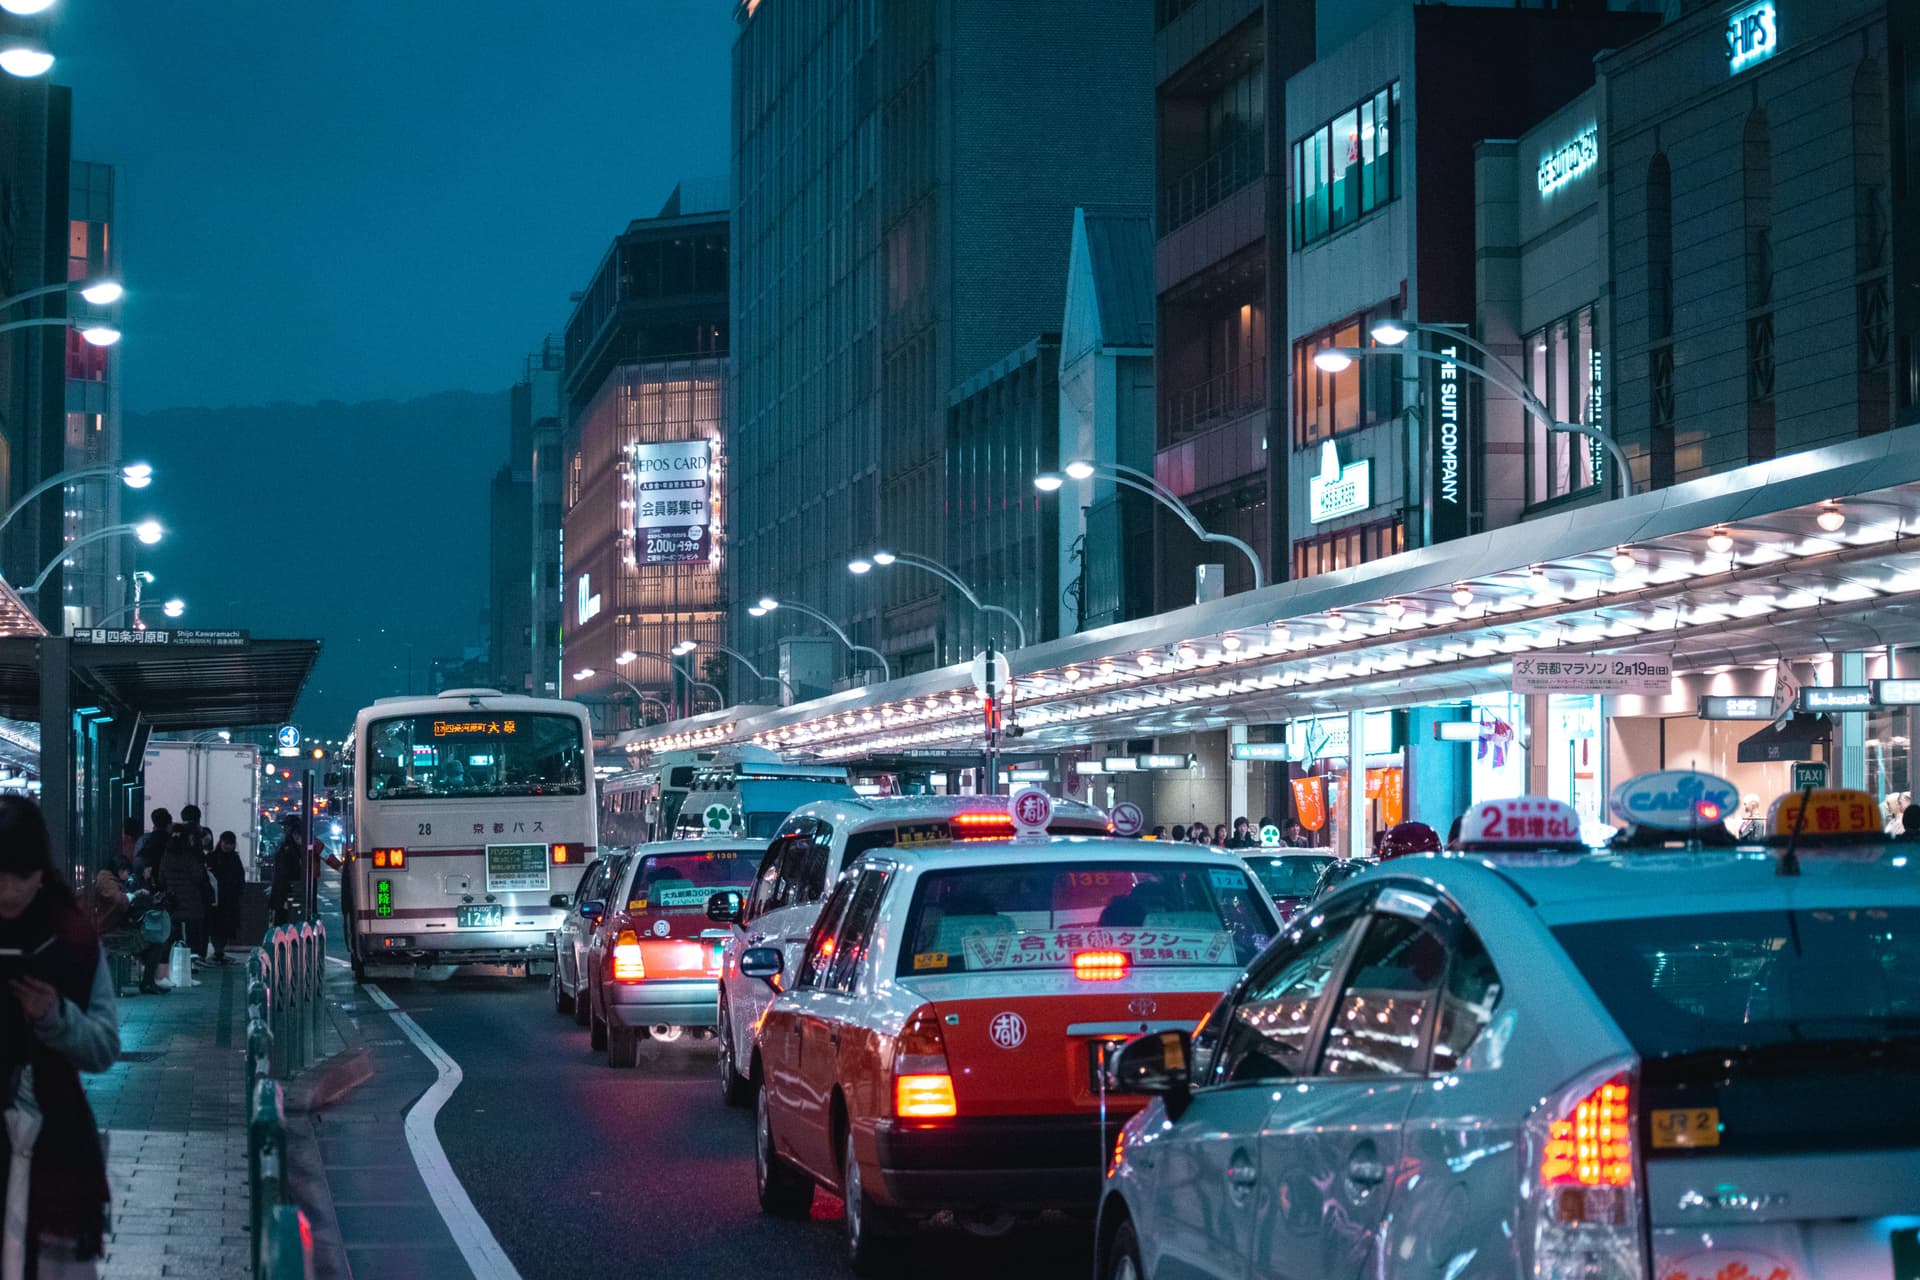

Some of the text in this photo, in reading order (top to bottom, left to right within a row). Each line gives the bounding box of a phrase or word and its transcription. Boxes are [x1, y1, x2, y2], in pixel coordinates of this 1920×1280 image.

[1725, 10, 1767, 60] SHIPS
[1441, 346, 1458, 504] THE SUIT COMPANY
[639, 456, 707, 473] EPOS CARD
[642, 499, 703, 517] 会員募集中
[107, 631, 169, 643] 四条河原町
[1536, 662, 1607, 675] 京都マラソン
[1615, 661, 1669, 676] 2月19日(日)
[1798, 769, 1822, 781] TAXI
[1021, 796, 1046, 821] 都
[418, 823, 432, 836] 28
[473, 821, 544, 834] 京都バス
[379, 881, 391, 916] 乗降中
[1117, 932, 1203, 947] タクシー
[1011, 950, 1067, 963] ガンバレ
[993, 1015, 1022, 1046] 都
[1696, 1112, 1710, 1130] 2
